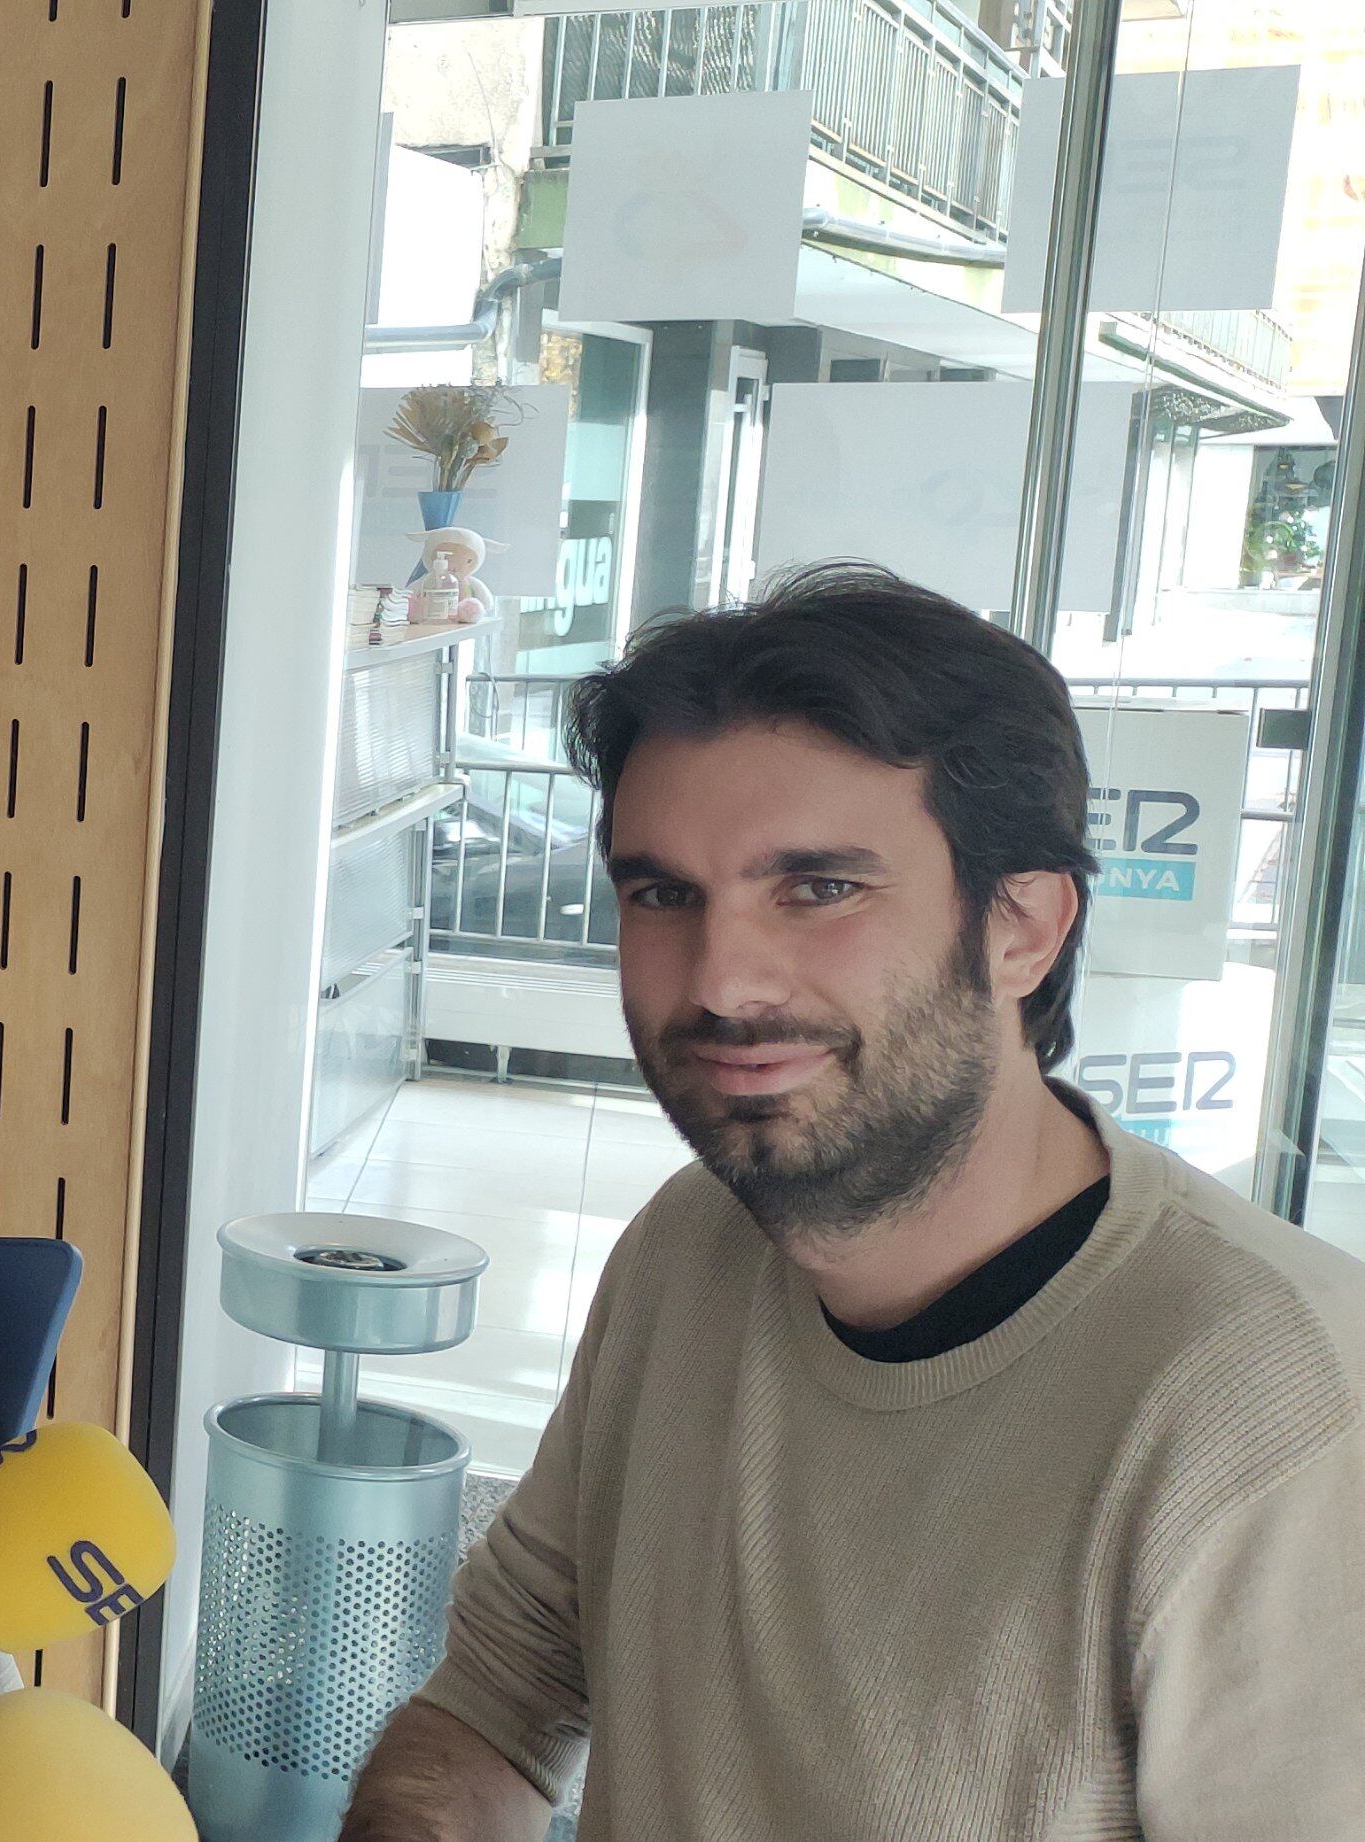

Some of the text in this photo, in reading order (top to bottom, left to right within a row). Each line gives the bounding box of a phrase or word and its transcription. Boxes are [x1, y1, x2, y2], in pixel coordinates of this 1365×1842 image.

[1086, 787, 1200, 856] ER
[1100, 866, 1181, 893] NYA
[1077, 1050, 1237, 1115] SER
[46, 1539, 145, 1626] SE
